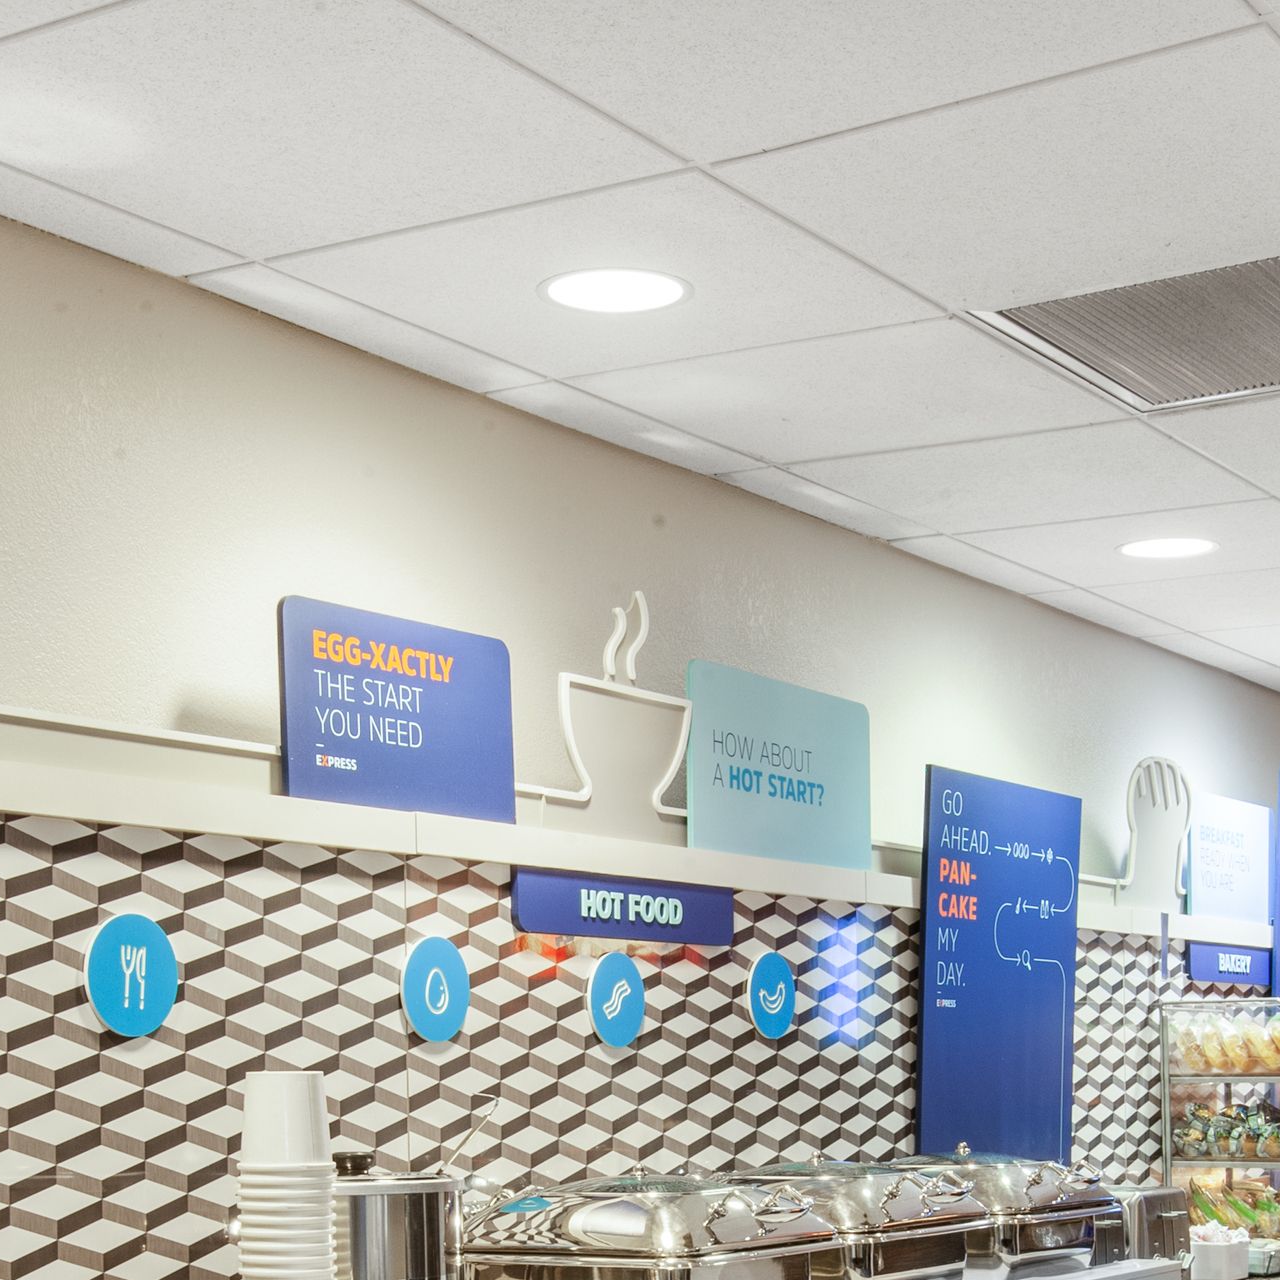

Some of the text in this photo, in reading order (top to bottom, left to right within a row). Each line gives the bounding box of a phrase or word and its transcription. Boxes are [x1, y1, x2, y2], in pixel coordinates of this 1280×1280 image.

[312, 629, 454, 683] EGG-XACTLY
[314, 669, 423, 713] THE START
[315, 706, 422, 748] YOU NEED
[316, 754, 357, 770] EXPRESS
[713, 729, 812, 773] HOW ABOUT
[712, 763, 825, 807] A HOT START?
[942, 789, 963, 816] GO
[940, 824, 992, 855] AHEAD.
[939, 857, 977, 886] PAN-
[580, 888, 683, 925] HOT FOOD
[938, 892, 977, 920] CAKE
[937, 927, 959, 952] MY
[937, 961, 966, 987] DAY.
[1218, 953, 1252, 973] BAKERY
